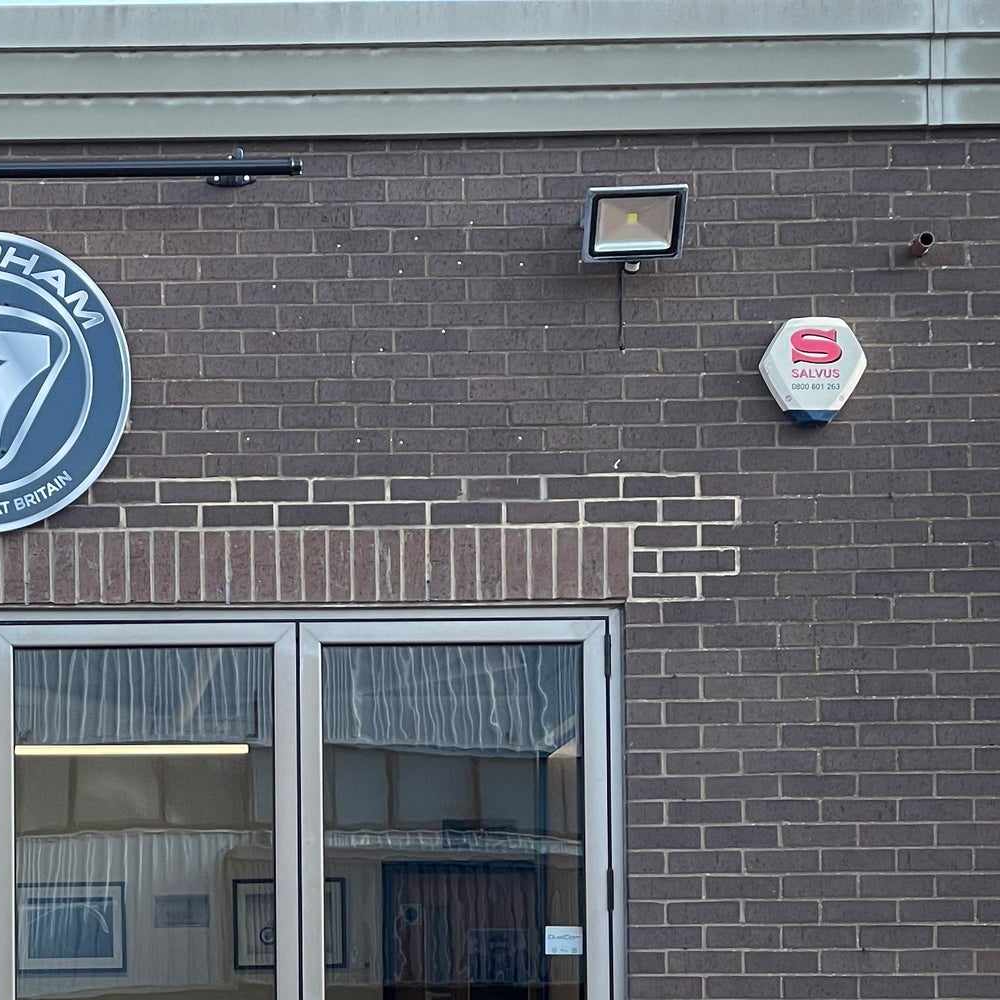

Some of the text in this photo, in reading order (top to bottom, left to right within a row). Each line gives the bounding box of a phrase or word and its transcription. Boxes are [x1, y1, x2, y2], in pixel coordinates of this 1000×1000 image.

[790, 328, 843, 364] S
[791, 368, 840, 379] SALVUS
[15, 470, 74, 512] BRITAIN
